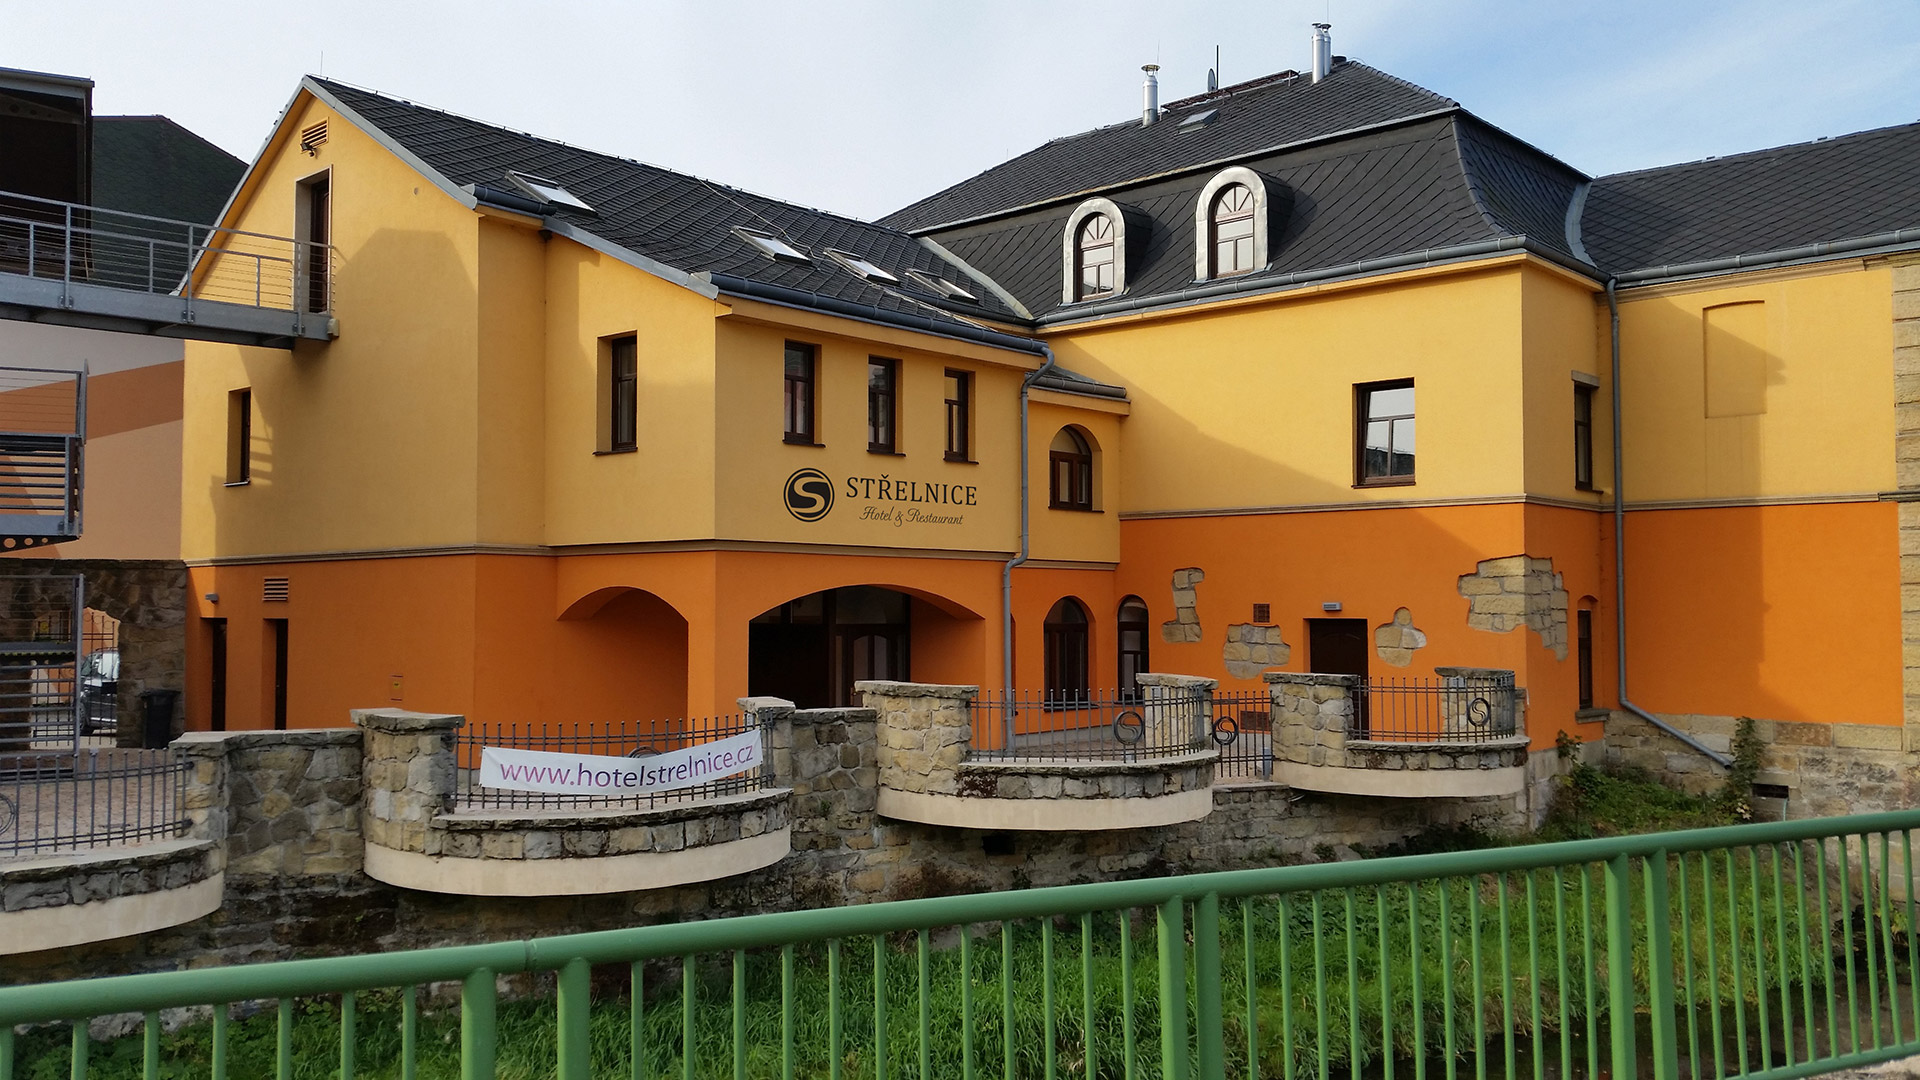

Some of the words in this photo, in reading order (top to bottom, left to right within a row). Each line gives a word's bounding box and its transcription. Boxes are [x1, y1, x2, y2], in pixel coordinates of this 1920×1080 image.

[846, 473, 977, 506] STŘELNICE
[859, 505, 894, 521] Hotel
[894, 510, 903, 527] &
[905, 507, 964, 525] Restaurant
[500, 745, 753, 788] www.hotelstrelnice.cz
